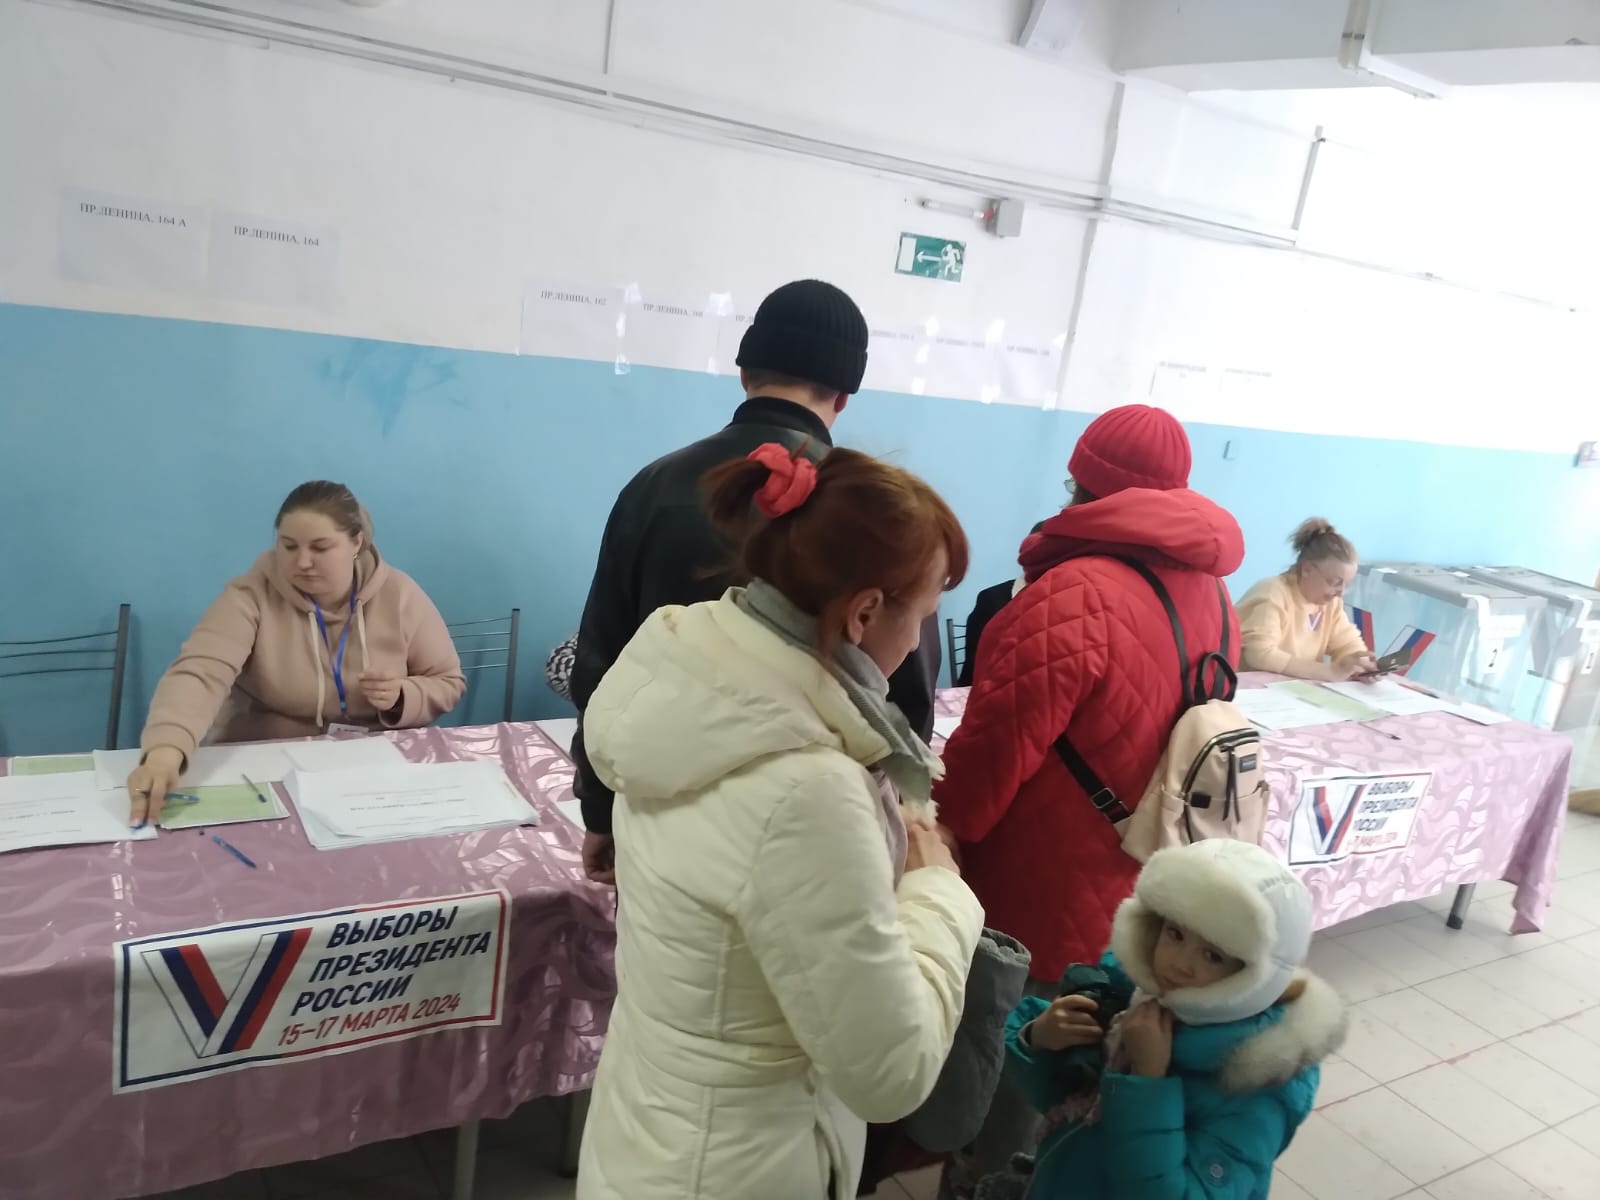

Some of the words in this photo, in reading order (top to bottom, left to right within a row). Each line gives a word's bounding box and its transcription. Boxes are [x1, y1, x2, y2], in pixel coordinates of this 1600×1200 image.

[326, 906, 459, 949] ВЫБОРЫ
[308, 931, 492, 984] ПРЕЗИДЕНТА
[290, 974, 414, 1017] РОССИИ
[338, 1002, 410, 1034] МАРТА
[412, 993, 462, 1020] 2024
